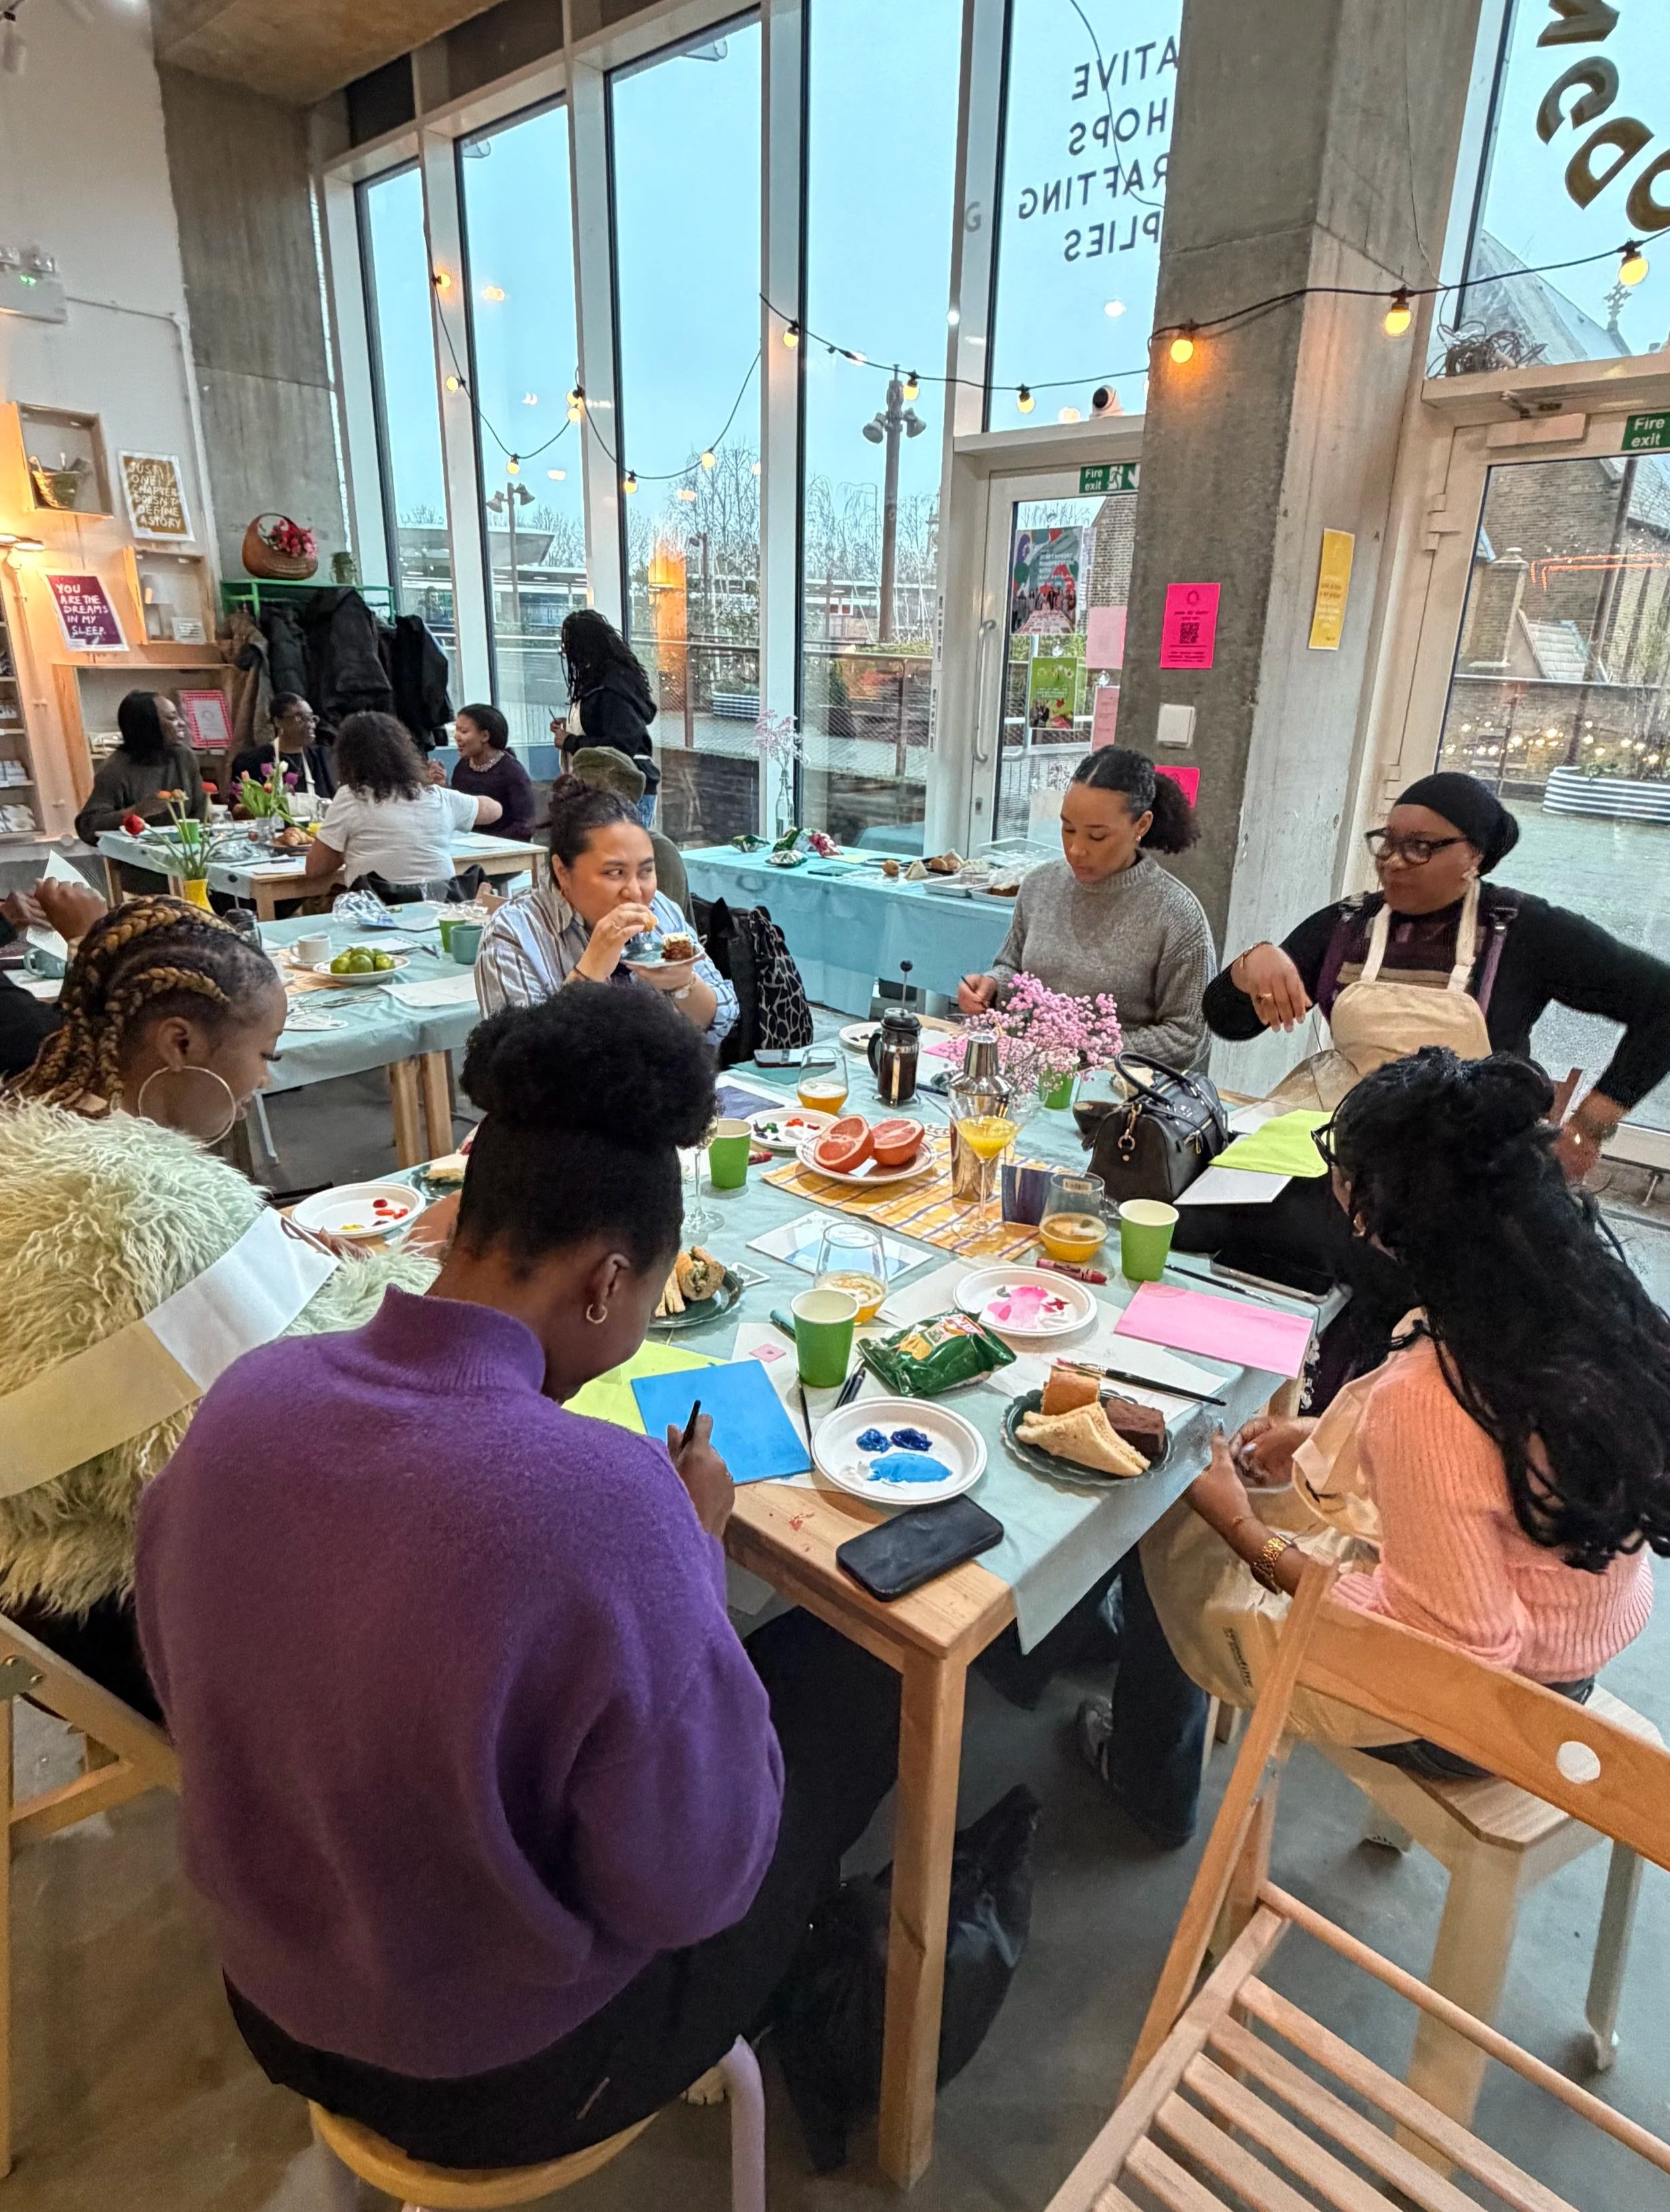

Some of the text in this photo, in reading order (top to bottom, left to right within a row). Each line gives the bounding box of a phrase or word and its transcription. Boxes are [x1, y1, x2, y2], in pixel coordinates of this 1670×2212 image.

[1634, 417, 1665, 431] Fire
[1631, 432, 1661, 447] exit
[1085, 468, 1103, 478] Fire
[130, 474, 156, 486] ONE
[1084, 480, 1102, 491] exit
[131, 484, 178, 498] CHAPTER
[135, 504, 179, 518] DEFINE
[148, 516, 181, 530] STORY
[55, 583, 80, 594] YOU
[60, 595, 102, 605] ARE THE
[63, 605, 109, 615] DREAMS
[67, 615, 97, 625] IN MY
